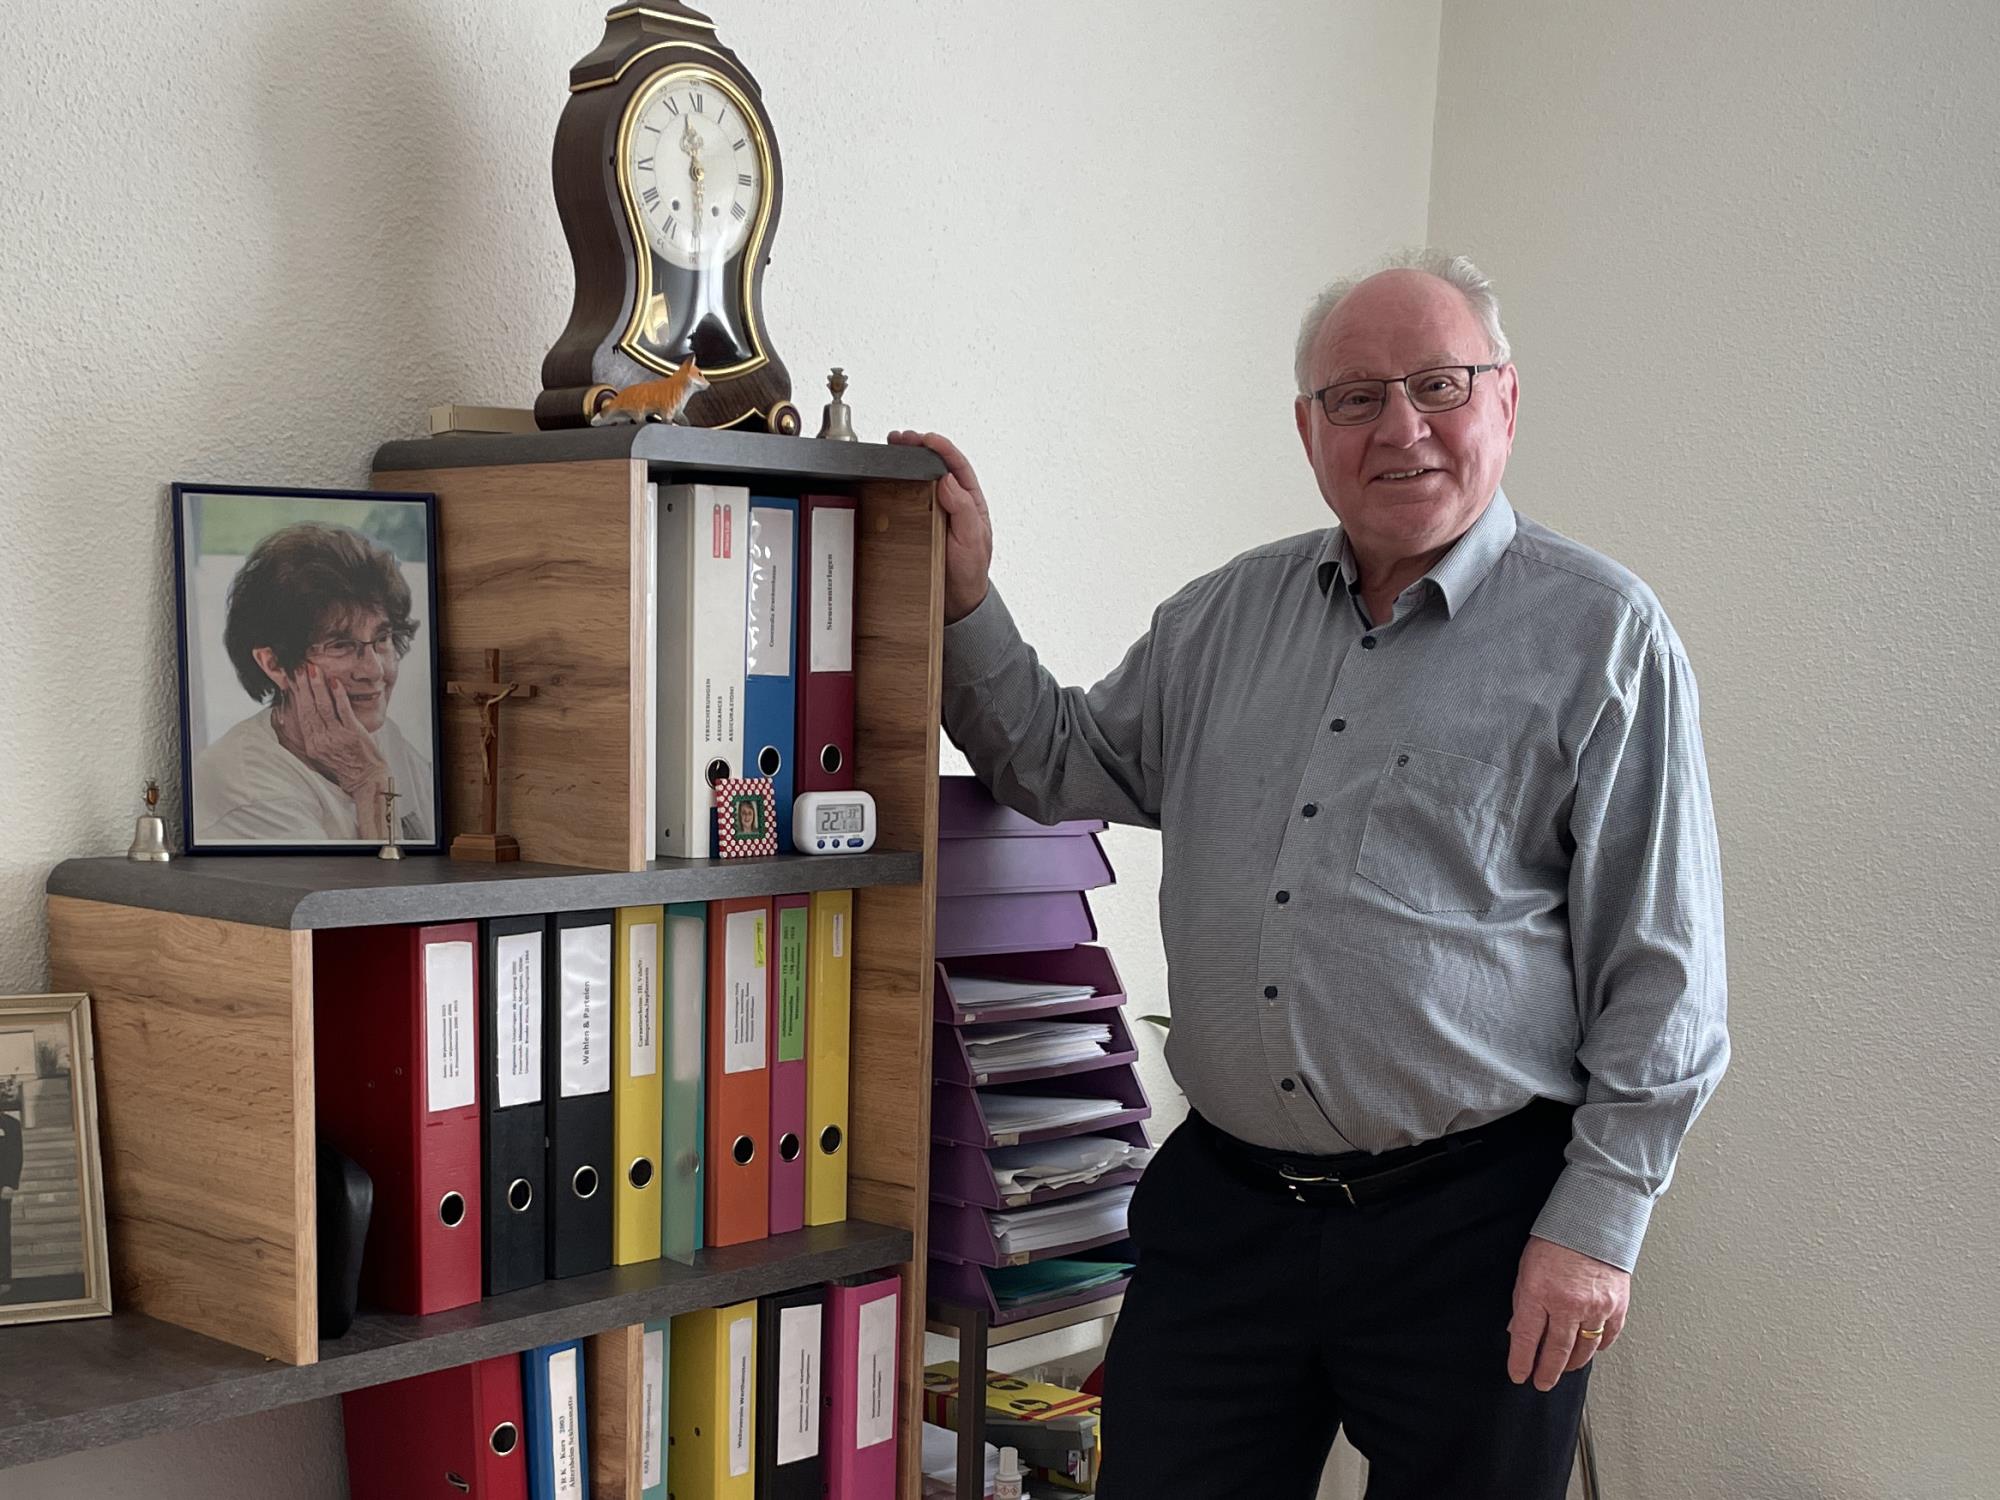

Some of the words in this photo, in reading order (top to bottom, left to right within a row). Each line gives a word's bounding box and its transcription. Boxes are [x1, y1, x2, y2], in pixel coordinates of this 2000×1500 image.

[826, 553, 835, 631] Steuerunterlagen
[582, 980, 590, 1019] Parteien
[582, 1020, 590, 1029] &
[582, 1030, 590, 1065] Wahlen
